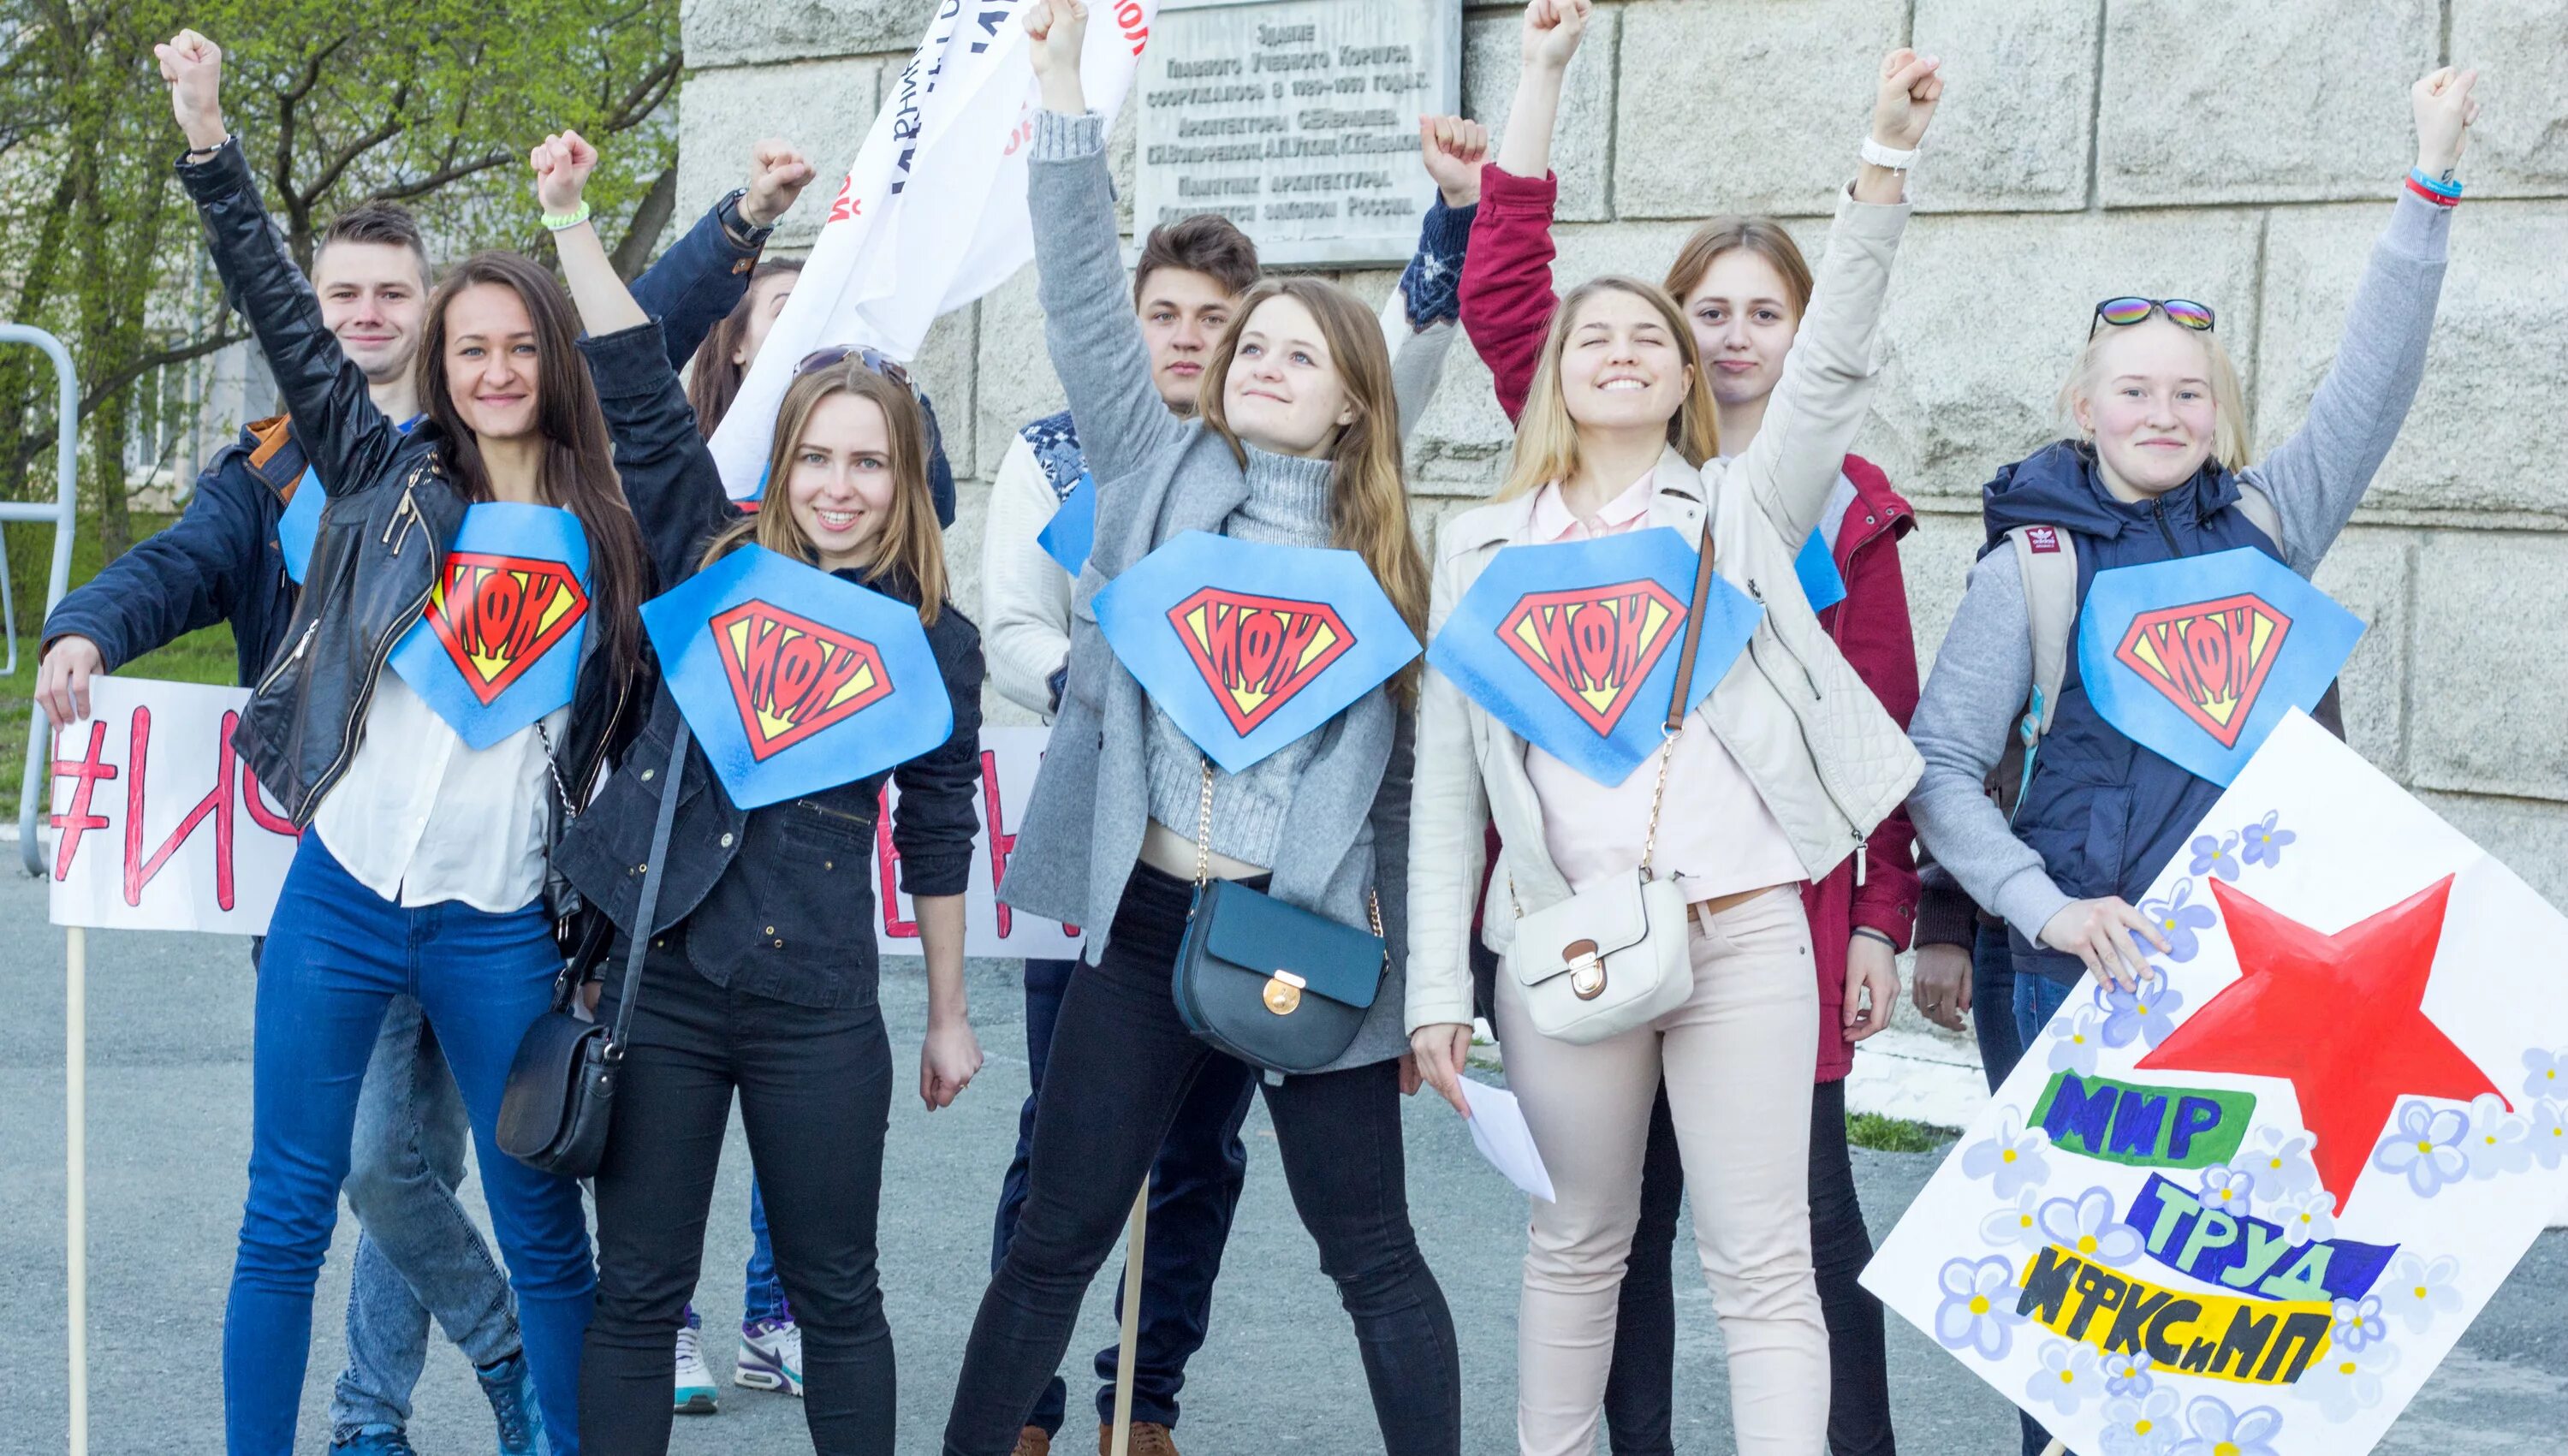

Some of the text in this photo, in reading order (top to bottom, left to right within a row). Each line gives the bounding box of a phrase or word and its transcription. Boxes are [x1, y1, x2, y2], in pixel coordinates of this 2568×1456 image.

[1147, 84, 1265, 107] СООРУЖАЛОСЬ
[1272, 81, 1284, 99] В
[1168, 45, 1413, 78] ГЛАВНОГО УЧЕБНОГО КОРПУСА
[1178, 175, 1260, 197] ПАМЯТНИК
[1263, 201, 1337, 221] ЗАКОНОМ
[443, 566, 561, 660] ИФК
[1205, 600, 1323, 694] ИФК
[1530, 592, 1650, 692] ИФК
[2144, 606, 2254, 704] ИФК
[746, 614, 866, 724] ИФК
[2043, 1074, 2222, 1159] МИР
[2146, 1182, 2335, 1301] ТРУД
